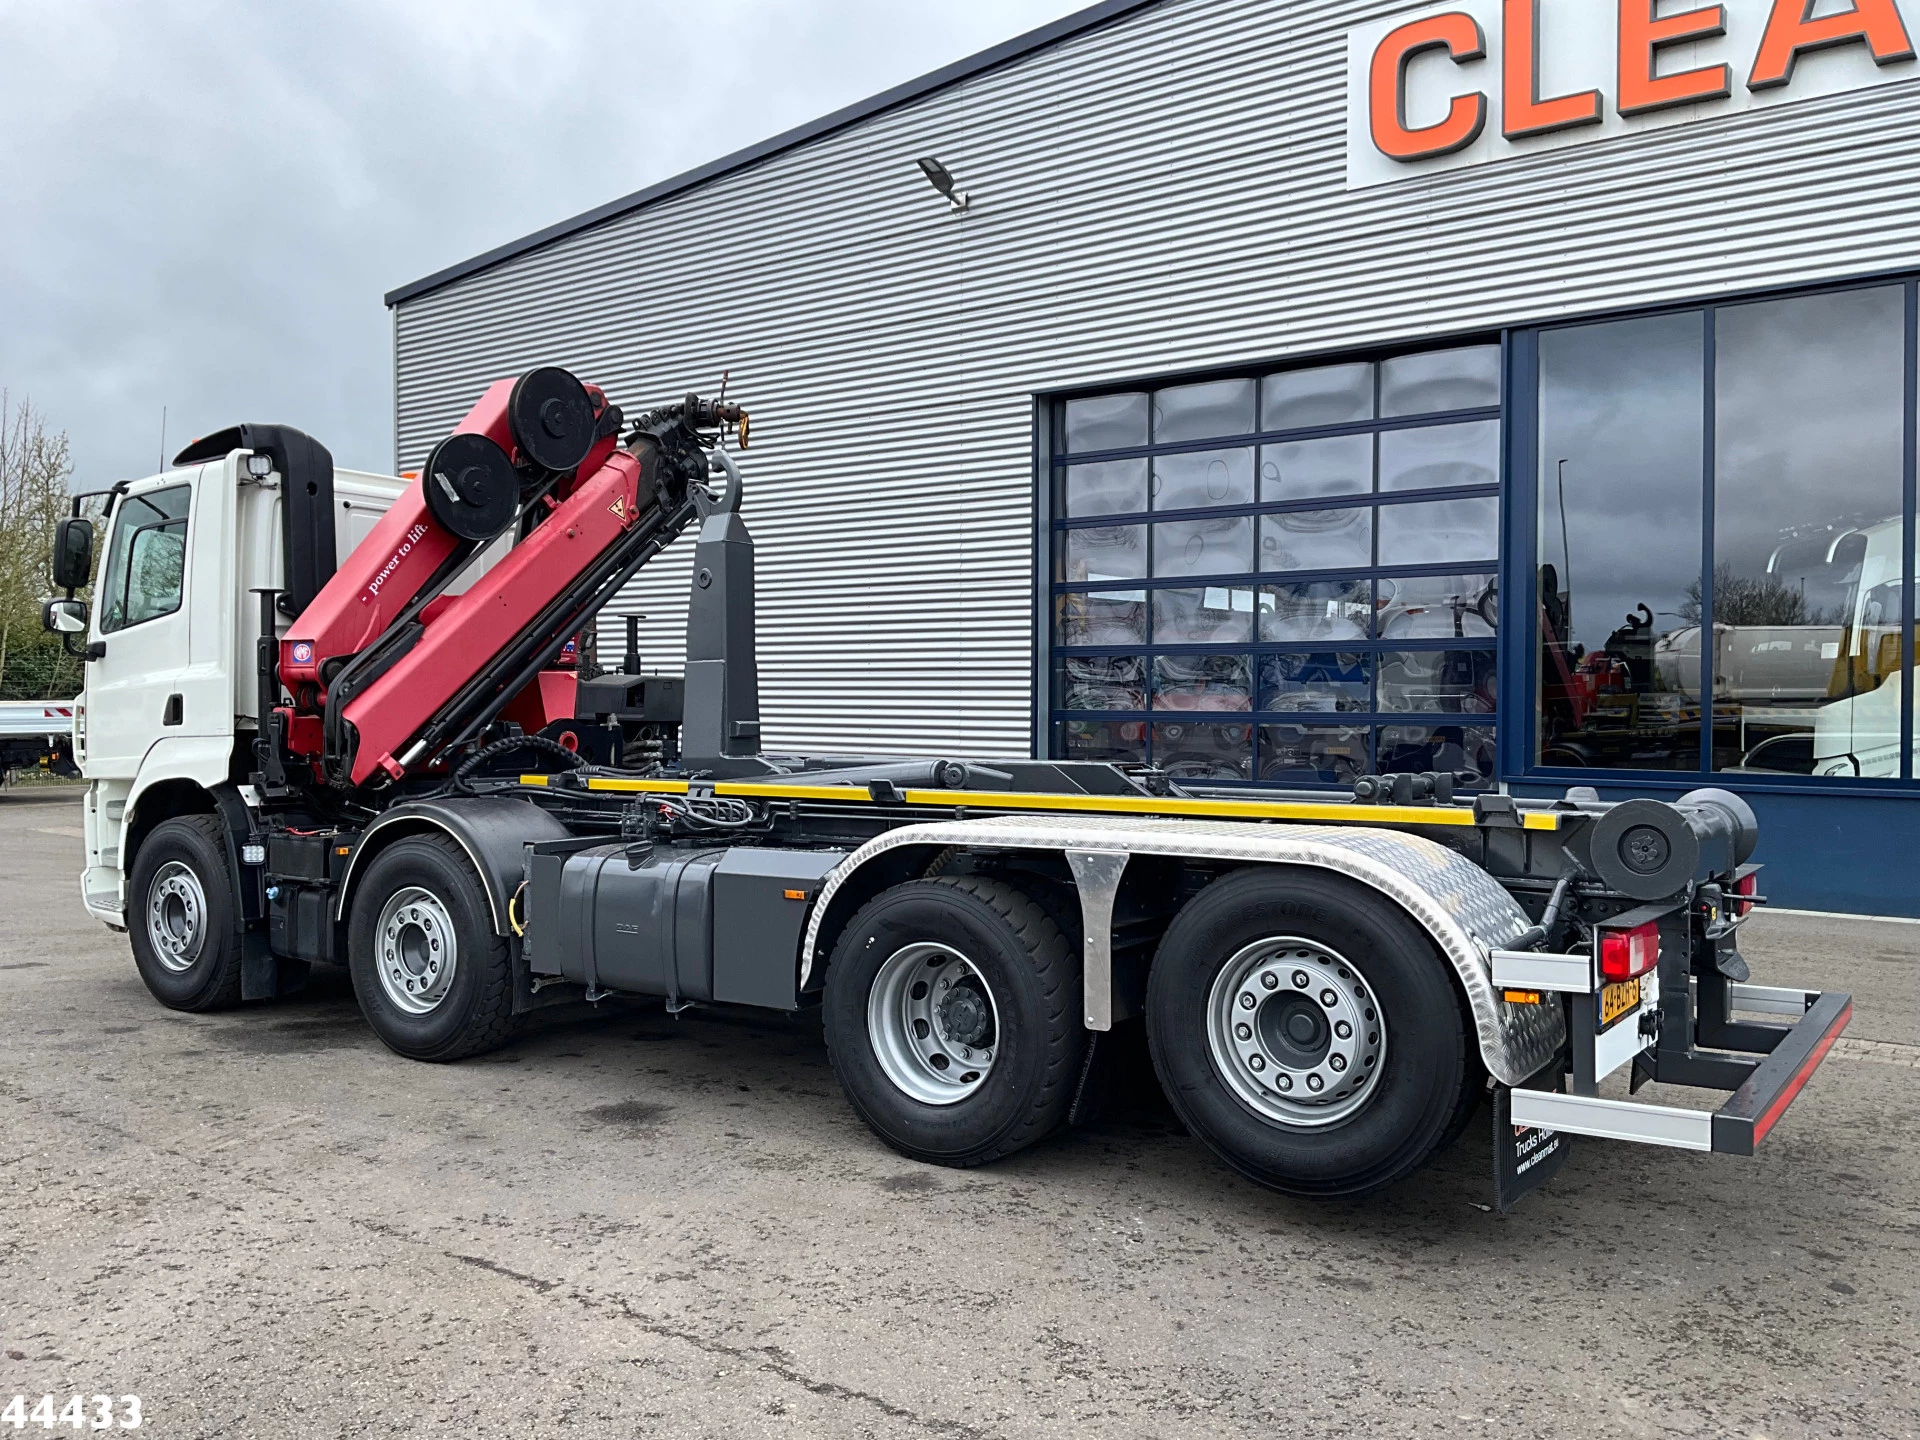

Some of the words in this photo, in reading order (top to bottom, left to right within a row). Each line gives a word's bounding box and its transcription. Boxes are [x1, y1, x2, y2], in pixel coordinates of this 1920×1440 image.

[1369, 0, 1917, 163] CLEA
[368, 555, 400, 596] power
[398, 543, 411, 556] to
[407, 524, 428, 545] lift.
[1515, 1134, 1538, 1158] Trucks
